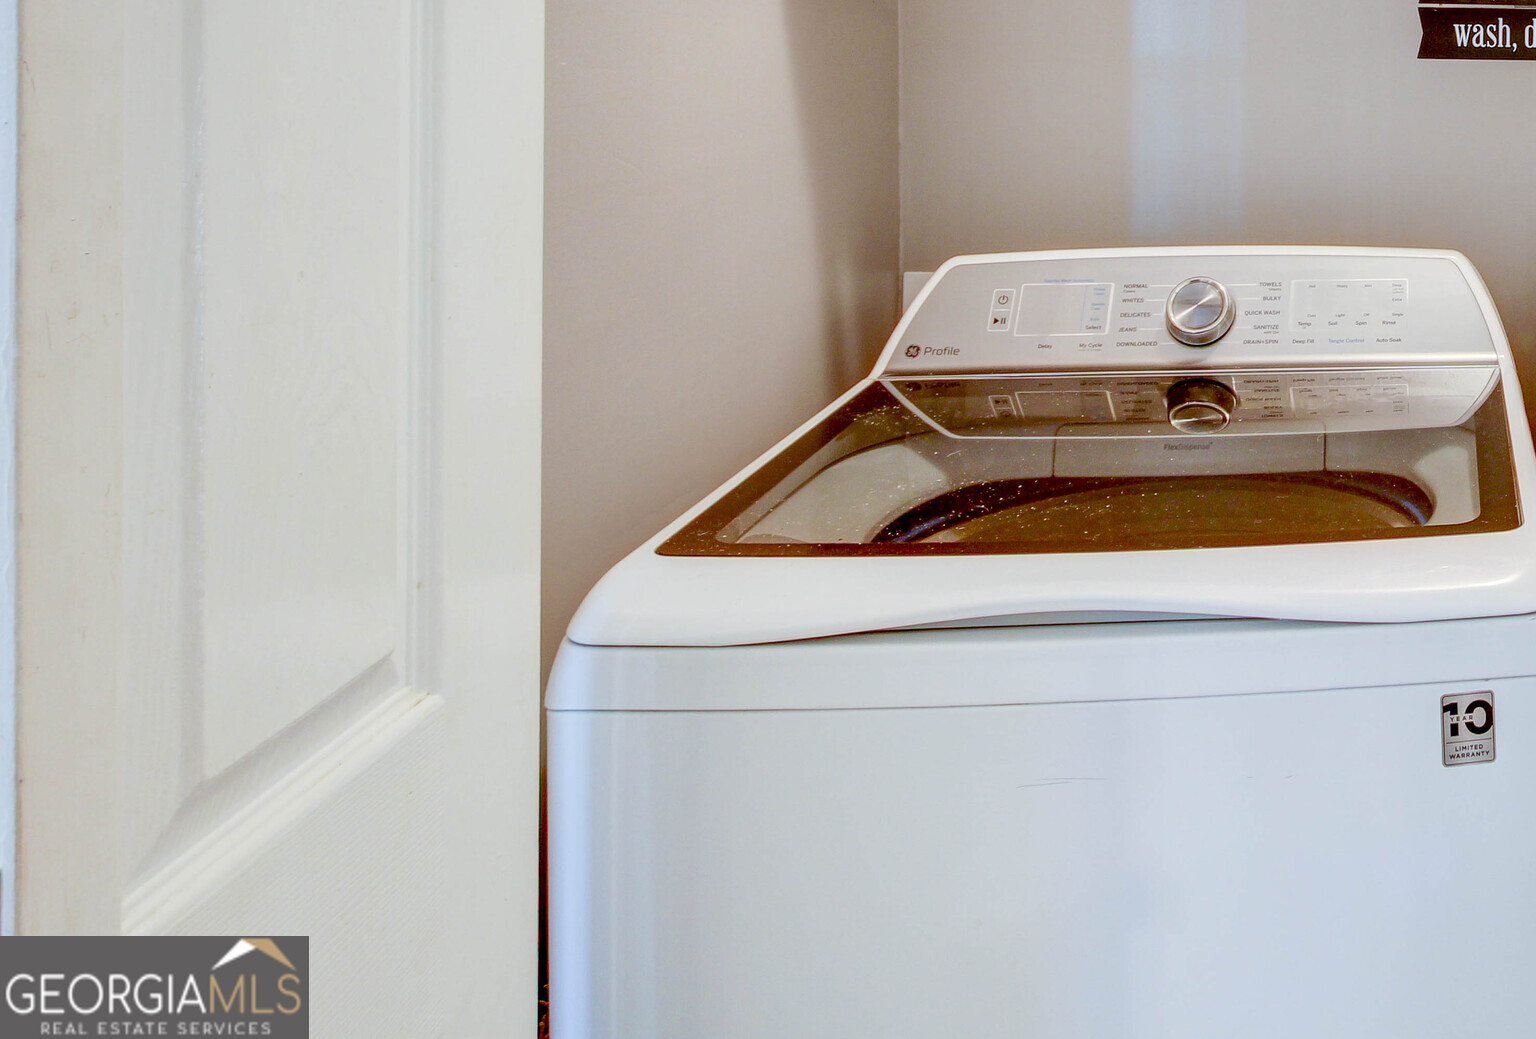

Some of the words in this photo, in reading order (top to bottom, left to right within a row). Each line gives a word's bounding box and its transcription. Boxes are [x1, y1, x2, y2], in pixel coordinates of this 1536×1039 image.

[1453, 17, 1518, 53] wash,
[1297, 320, 1313, 328] Temp
[923, 346, 960, 356] Profile
[1443, 699, 1493, 737] 10
[1450, 714, 1473, 723] YEAR
[1454, 744, 1484, 752] LIMITED
[1449, 750, 1490, 760] WARRANTY
